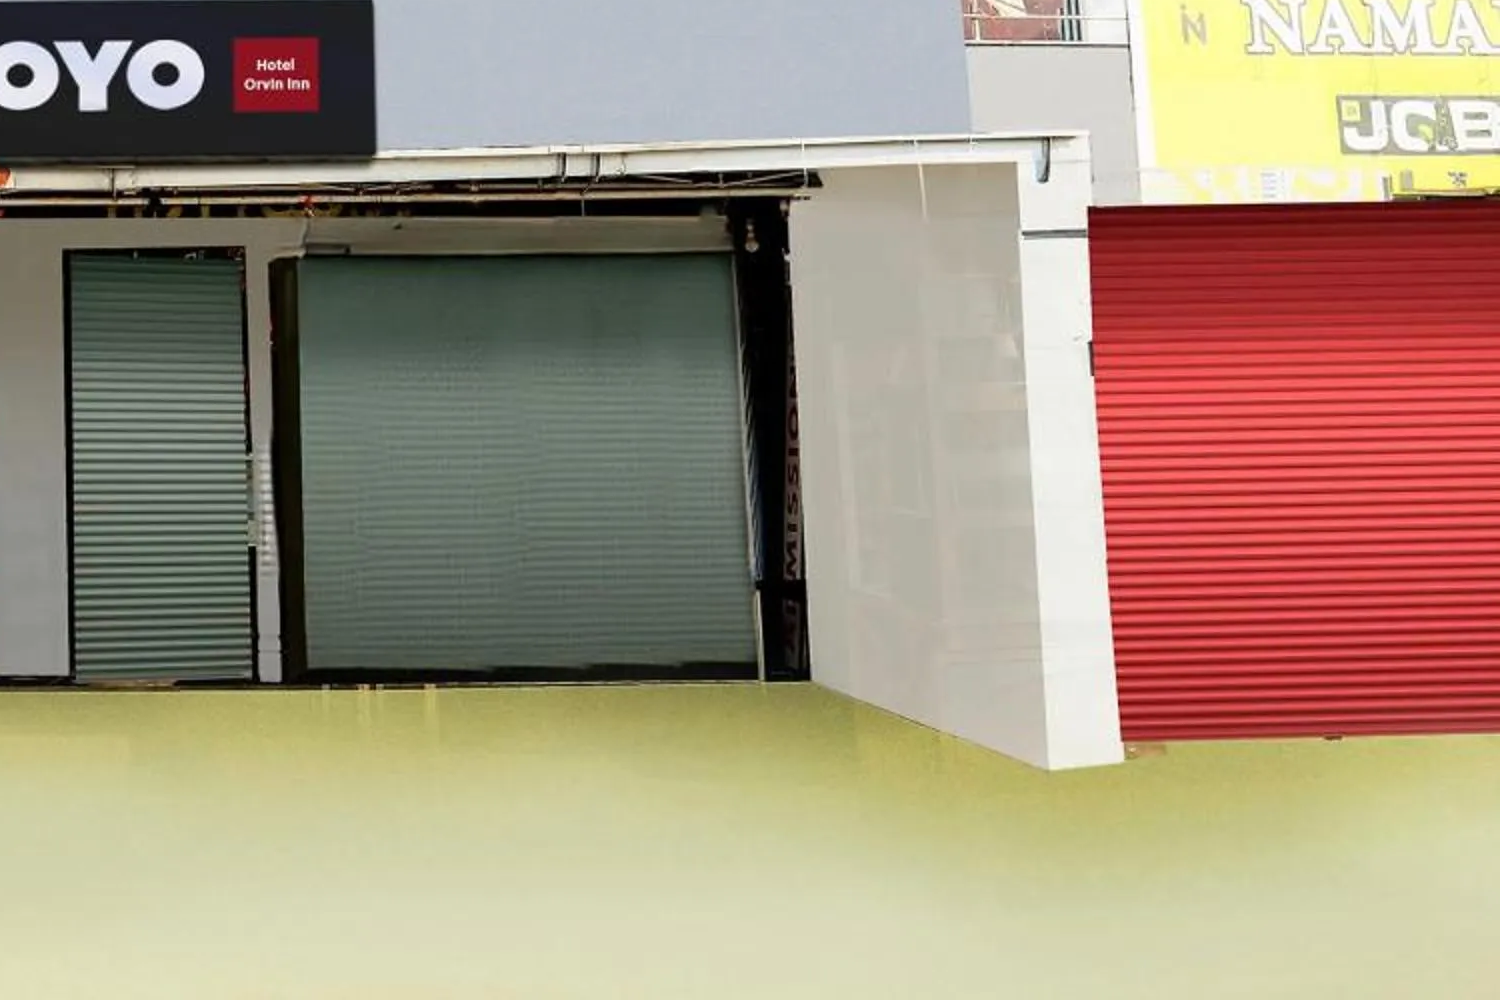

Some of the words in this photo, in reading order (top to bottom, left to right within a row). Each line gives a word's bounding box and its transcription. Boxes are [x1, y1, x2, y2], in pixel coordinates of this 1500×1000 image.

[256, 57, 296, 71] Hotel
[244, 77, 284, 91] Orvin
[287, 77, 311, 91] Inn
[1340, 98, 1500, 152] JCB
